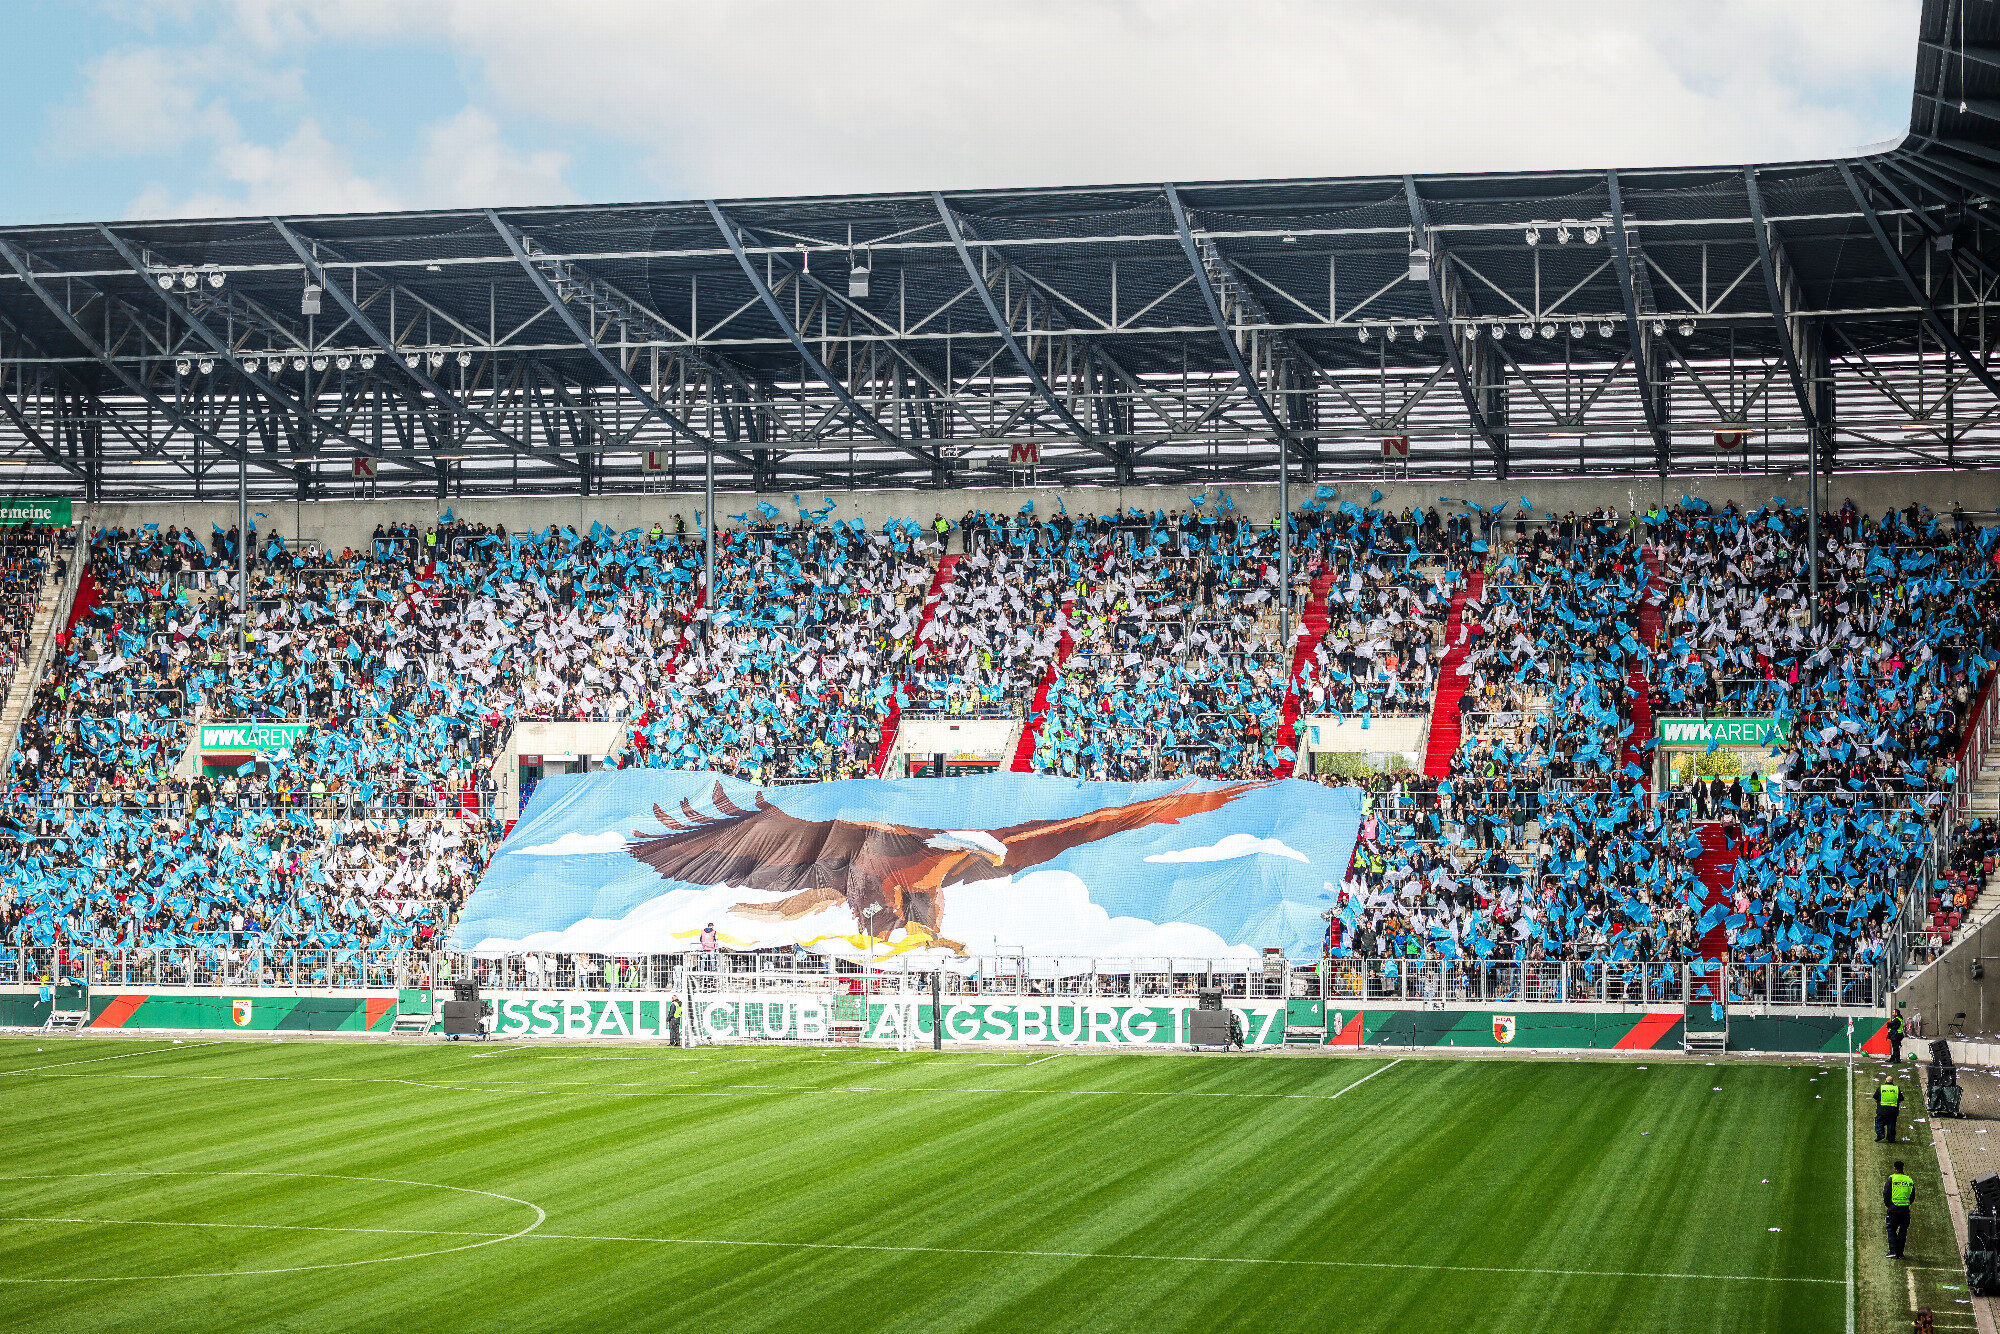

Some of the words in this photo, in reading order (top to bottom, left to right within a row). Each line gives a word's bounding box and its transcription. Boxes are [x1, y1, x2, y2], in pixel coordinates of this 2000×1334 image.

[1010, 443, 1039, 462] M
[1383, 436, 1408, 455] N
[354, 457, 375, 475] K
[648, 451, 662, 470] L
[77, 989, 82, 999] 1
[420, 993, 427, 1003] 2
[1310, 1003, 1319, 1015] 4
[702, 1000, 827, 1040] CLUB
